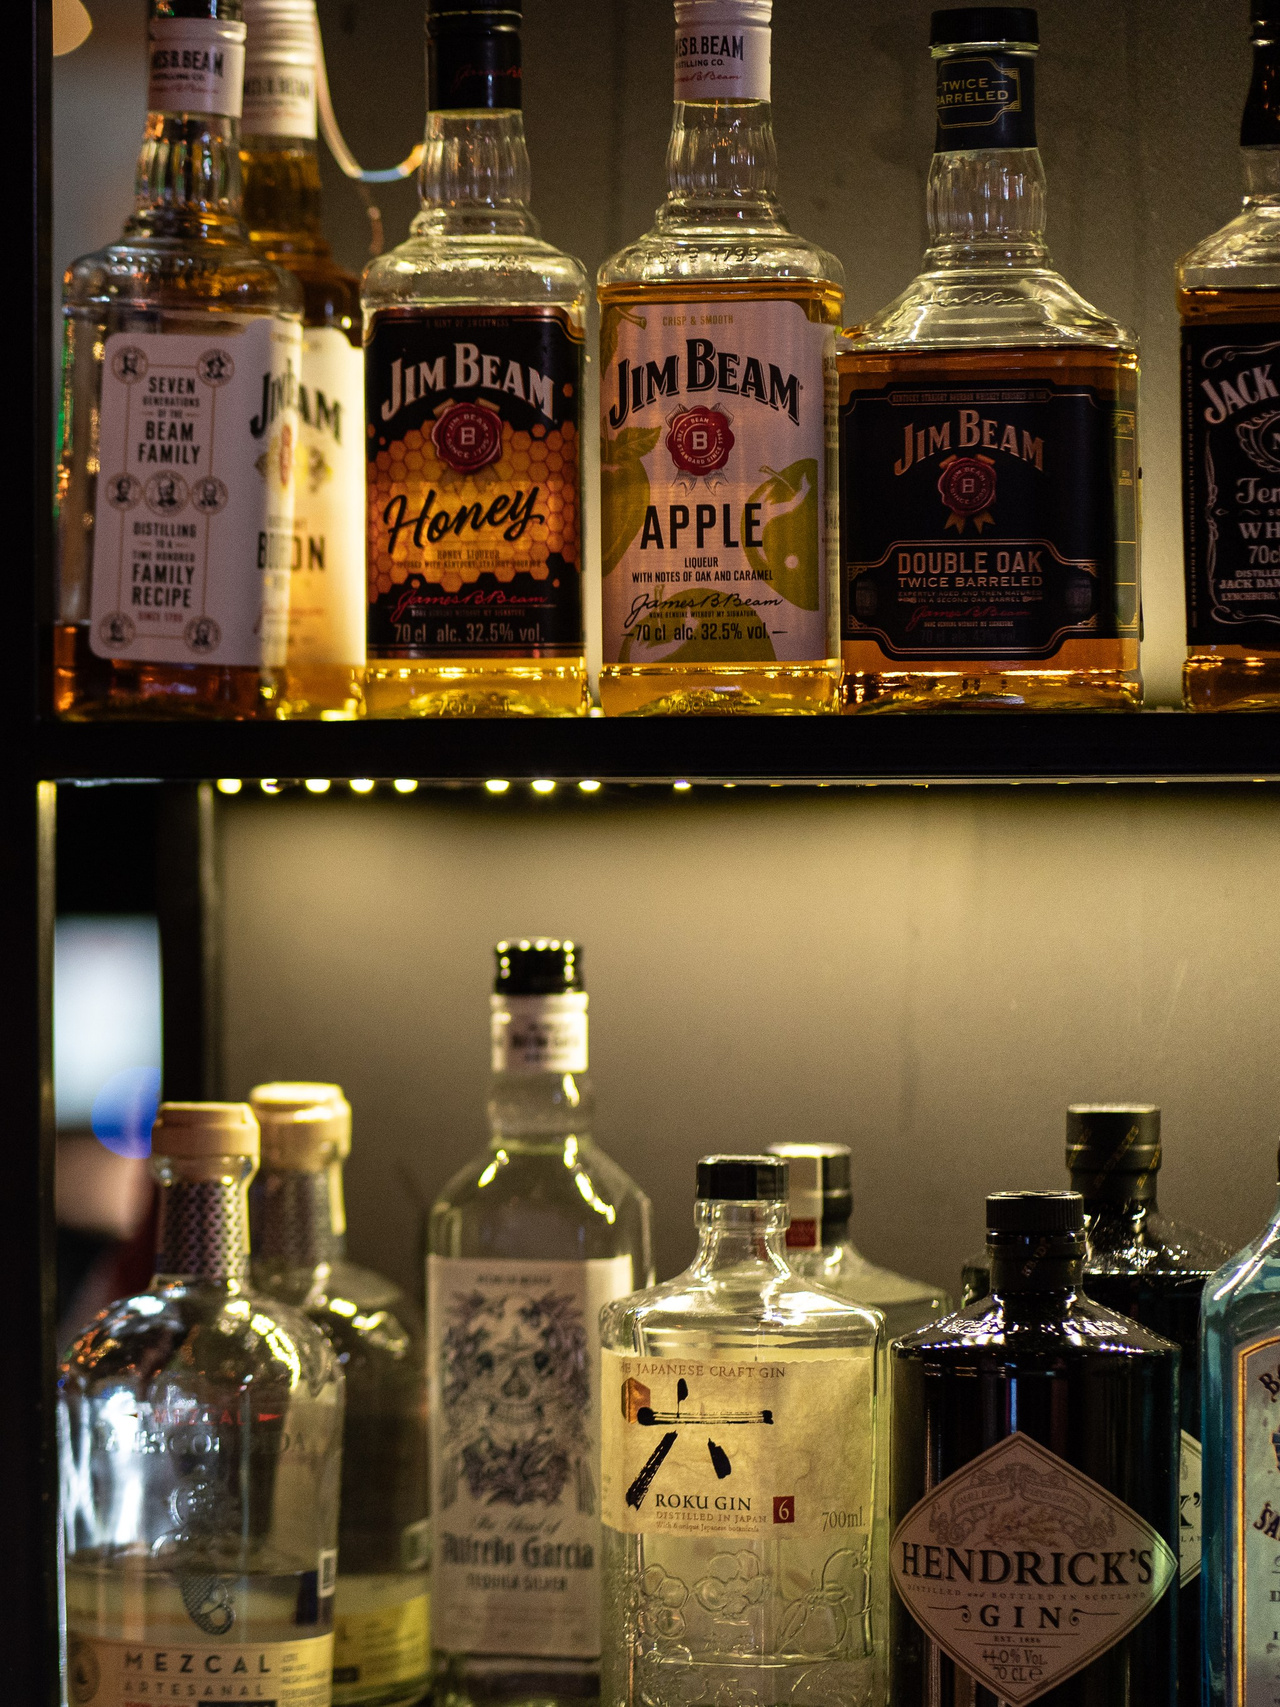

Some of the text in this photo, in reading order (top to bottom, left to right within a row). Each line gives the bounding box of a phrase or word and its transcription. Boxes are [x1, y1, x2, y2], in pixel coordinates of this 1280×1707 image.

[701, 35, 744, 62] BEAM
[181, 50, 224, 78] BEAM
[710, 57, 725, 67] CO.
[941, 76, 990, 92] TWICE
[662, 314, 734, 327] CRISP & SMOOTH
[148, 376, 196, 394] SEVEN
[381, 342, 556, 422] JIM BEAM
[608, 352, 681, 431] JIM
[685, 337, 801, 427] BEAM
[1200, 363, 1280, 425] JACK
[690, 416, 710, 425] BEAM
[145, 420, 195, 442] BEAM
[893, 408, 1045, 477] JIM BEAM
[137, 443, 201, 465] FAMILY
[133, 521, 197, 538] DISTILLING
[382, 486, 546, 555] Honey
[639, 502, 763, 550] APPLE
[465, 550, 501, 560] LIQUEUR
[684, 556, 719, 570] LIQUEUR
[897, 551, 1044, 574] DOUBLE OAK
[132, 563, 195, 585] FAMILY
[631, 569, 774, 583] WITH NOTES OF OAK AND CARAMEL
[897, 576, 1044, 588] TWICE BARRELED
[1218, 579, 1254, 589] JACK
[131, 586, 192, 608] RECIPE
[390, 589, 459, 623] James
[486, 589, 550, 605] Beam
[623, 592, 701, 629] James
[720, 592, 784, 607] Beam
[649, 609, 758, 619] NONE GENUINE WITHOUT MY SIGNATURE
[393, 622, 545, 643] 70 cl alc. 32.5% vol.
[634, 621, 771, 641] 70 cl alc. 32.5% vol.
[636, 1362, 786, 1379] JAPANESE CRAFT GIN
[655, 1493, 752, 1511] ROKU GIN
[778, 1500, 791, 1521] 6
[656, 1511, 767, 1524] DISTILLED IN JAPAN
[700, 1523, 727, 1532] Japanese
[901, 1541, 1154, 1588] HENDRICK'S
[991, 1592, 1055, 1600] BOTTLED
[1061, 1593, 1079, 1601] IN
[979, 1603, 1062, 1630] GIN
[993, 1634, 1016, 1644] EST.
[124, 1651, 273, 1675] MEZCAL
[122, 1681, 265, 1698] ARTESANAL
